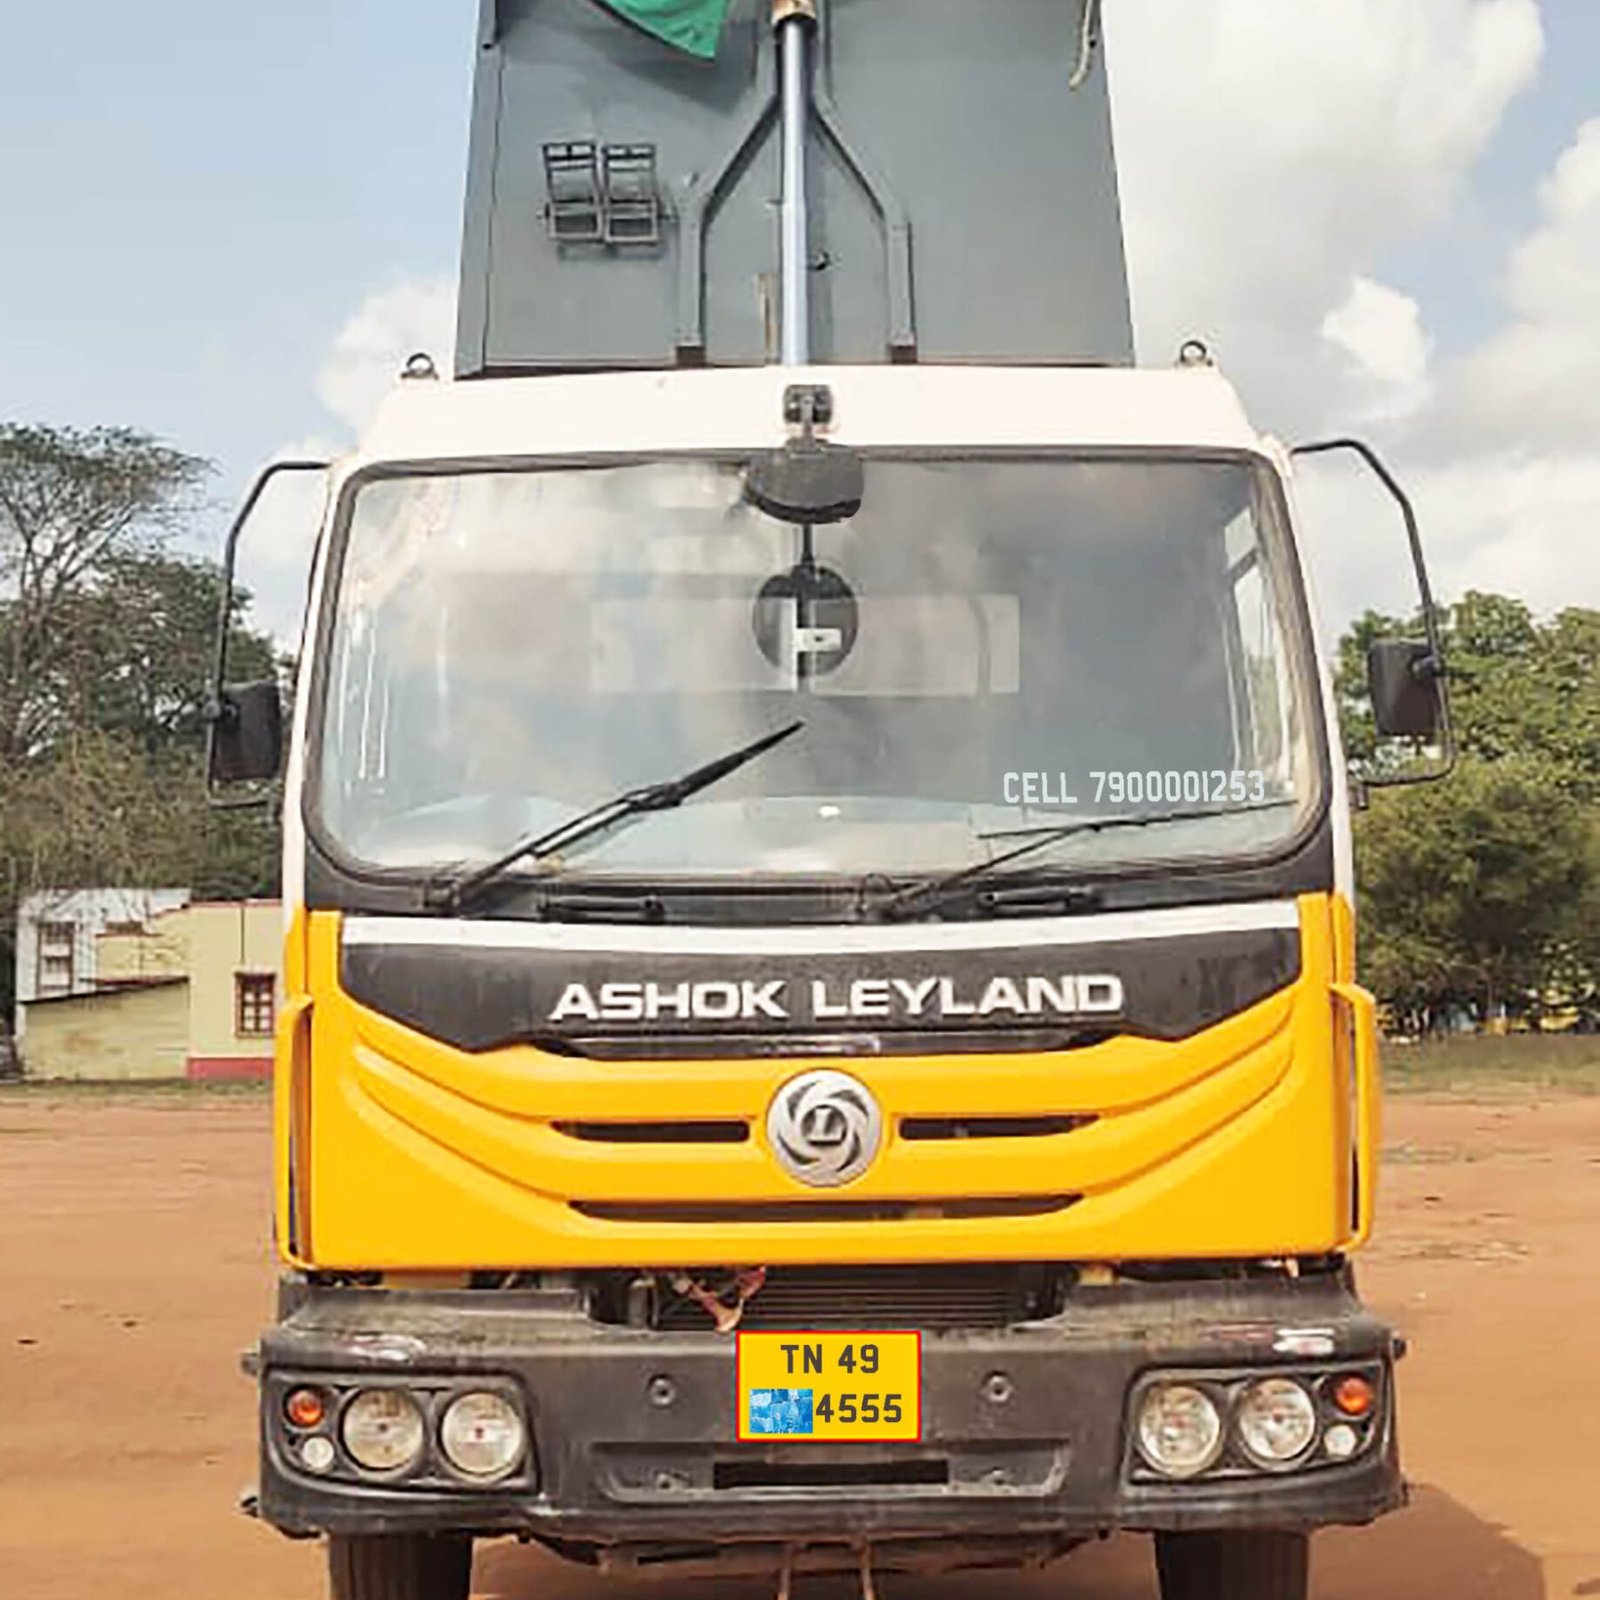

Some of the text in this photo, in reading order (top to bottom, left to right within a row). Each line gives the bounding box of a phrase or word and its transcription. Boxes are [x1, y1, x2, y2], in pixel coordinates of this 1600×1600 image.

[1003, 770, 1265, 803] CELL 7900001253
[549, 976, 1124, 1021] ASHOK LEYLAND
[780, 1344, 879, 1374] TN 49
[815, 1393, 902, 1423] 4555
